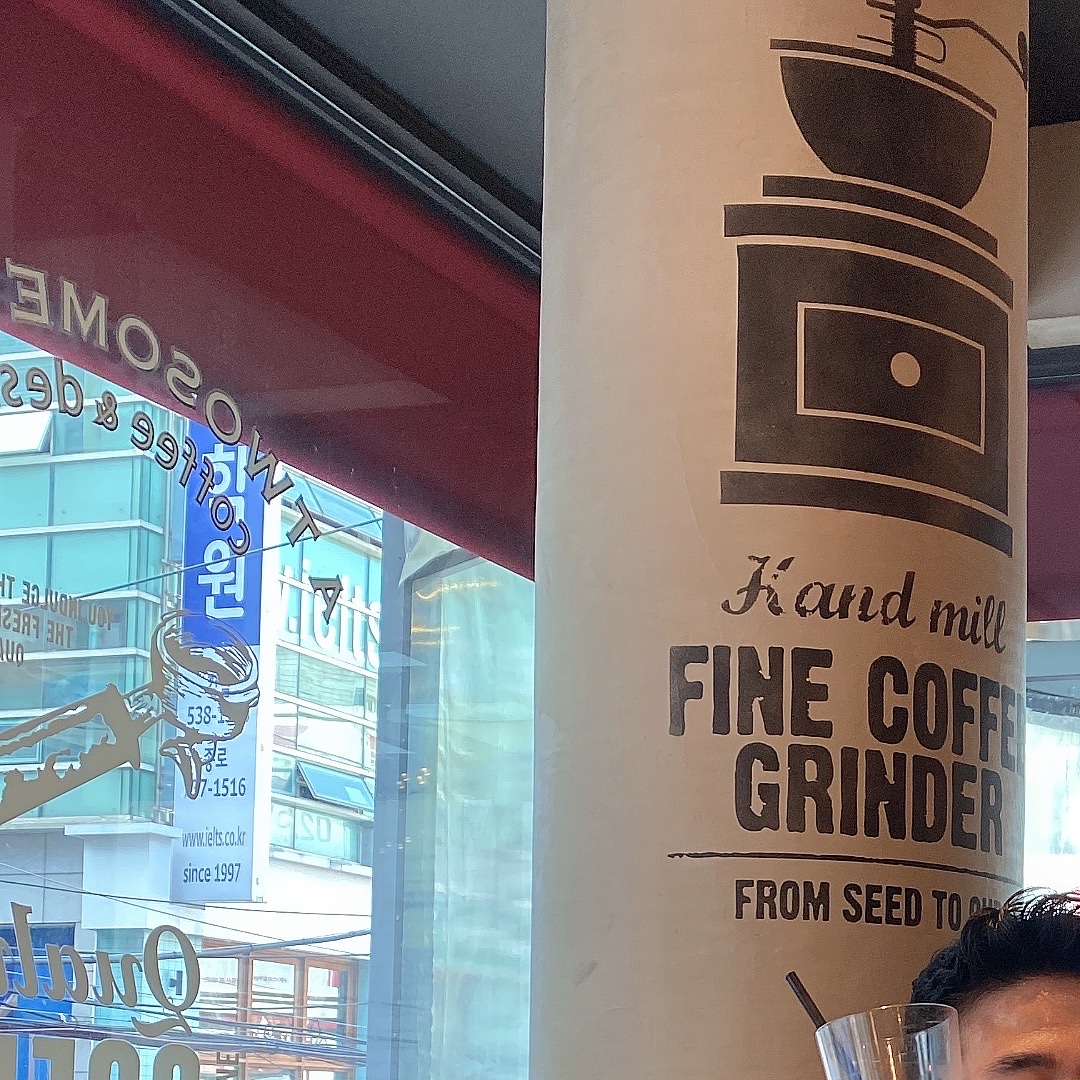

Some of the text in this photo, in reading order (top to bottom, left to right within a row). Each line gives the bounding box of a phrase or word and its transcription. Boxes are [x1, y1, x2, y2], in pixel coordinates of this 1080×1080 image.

[929, 594, 1007, 654] mill
[669, 645, 833, 738] FINE
[184, 776, 247, 799] 7-1516
[735, 741, 1003, 856] GRINDER
[181, 826, 247, 848] www.ielts.co.kr
[183, 862, 242, 883] since 1997
[734, 879, 830, 922] FROM
[842, 882, 922, 927] SEED
[931, 889, 962, 932] TO
